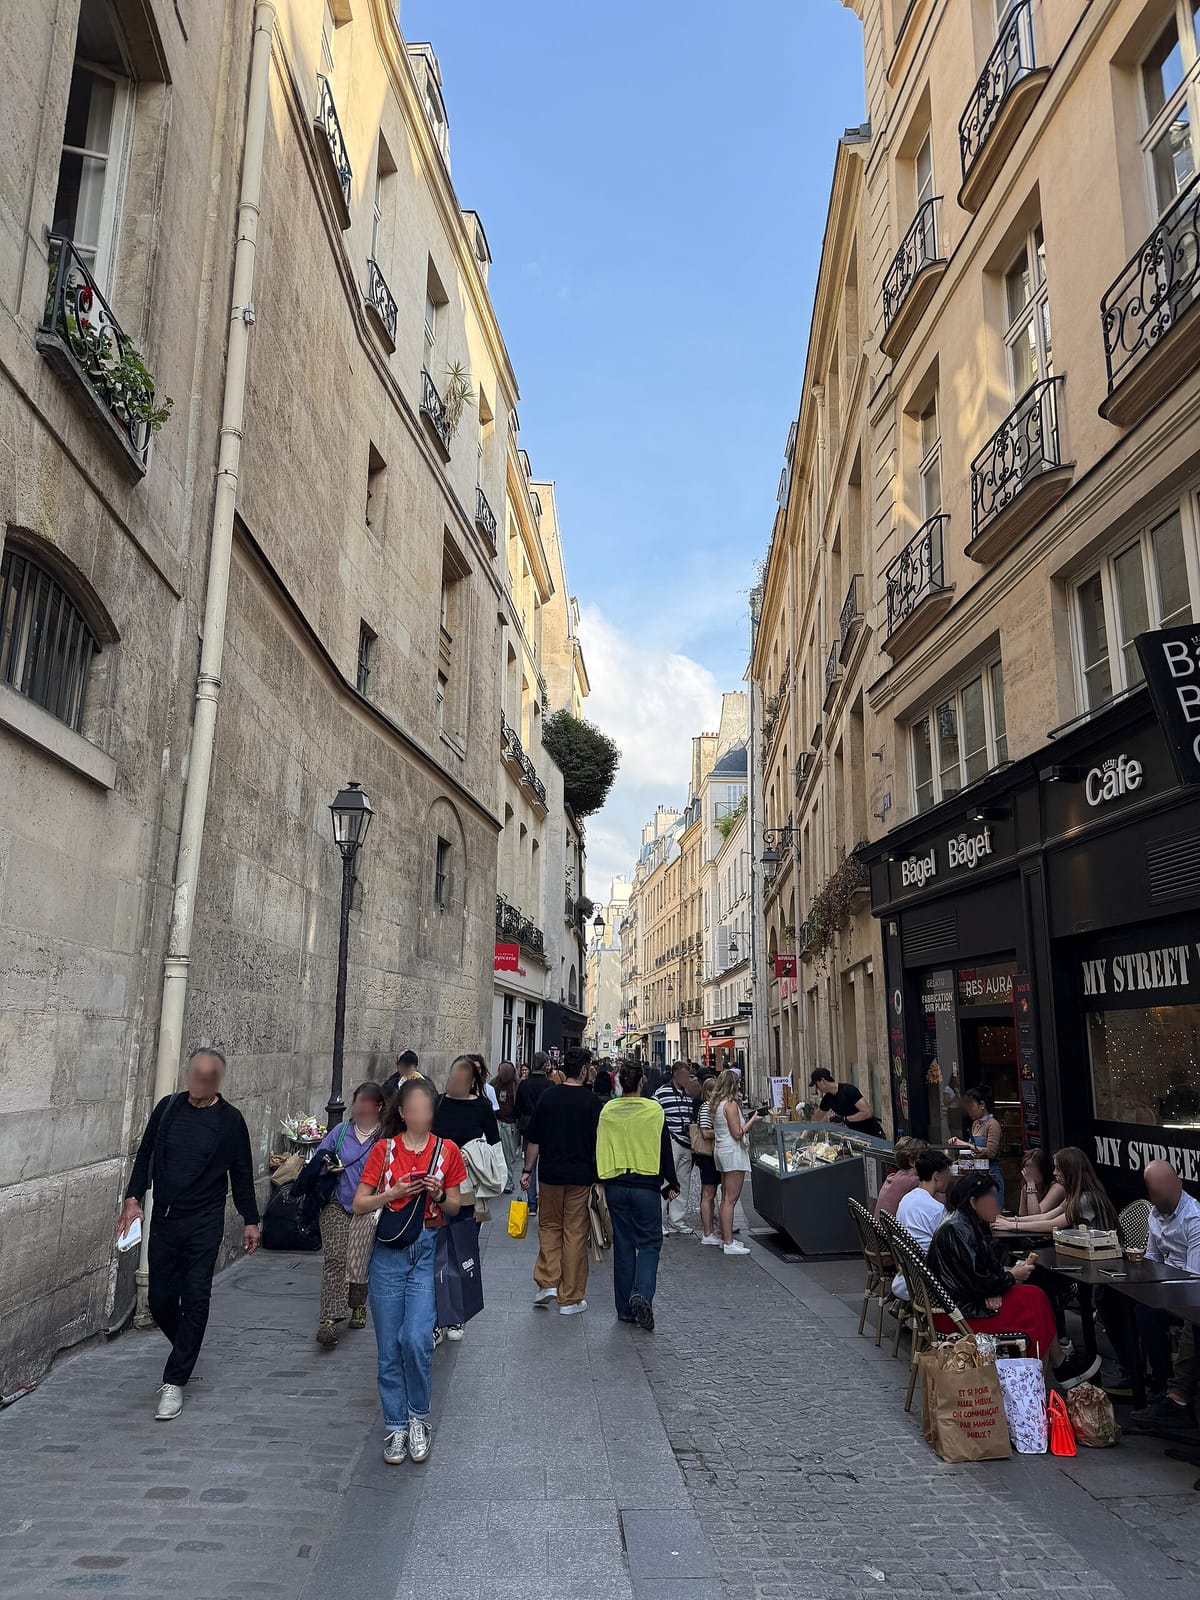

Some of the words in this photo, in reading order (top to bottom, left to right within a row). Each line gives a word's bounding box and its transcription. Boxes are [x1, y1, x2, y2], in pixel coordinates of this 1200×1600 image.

[1162, 641, 1200, 678] B
[901, 848, 936, 888] Bagel
[948, 825, 992, 869] Baget
[1081, 959, 1107, 996] MY
[1112, 945, 1190, 993] STREET
[921, 992, 953, 1004] FABRICATION
[925, 1003, 935, 1013] SUR
[935, 1002, 951, 1012] PLACE
[1094, 1135, 1121, 1167] MY
[1128, 1140, 1200, 1182] STREE
[958, 1389, 966, 1397] ET
[967, 1388, 973, 1396] SI
[974, 1386, 989, 1395] POUR
[973, 1418, 996, 1428] MANGER
[967, 1431, 987, 1439] MIEUX
